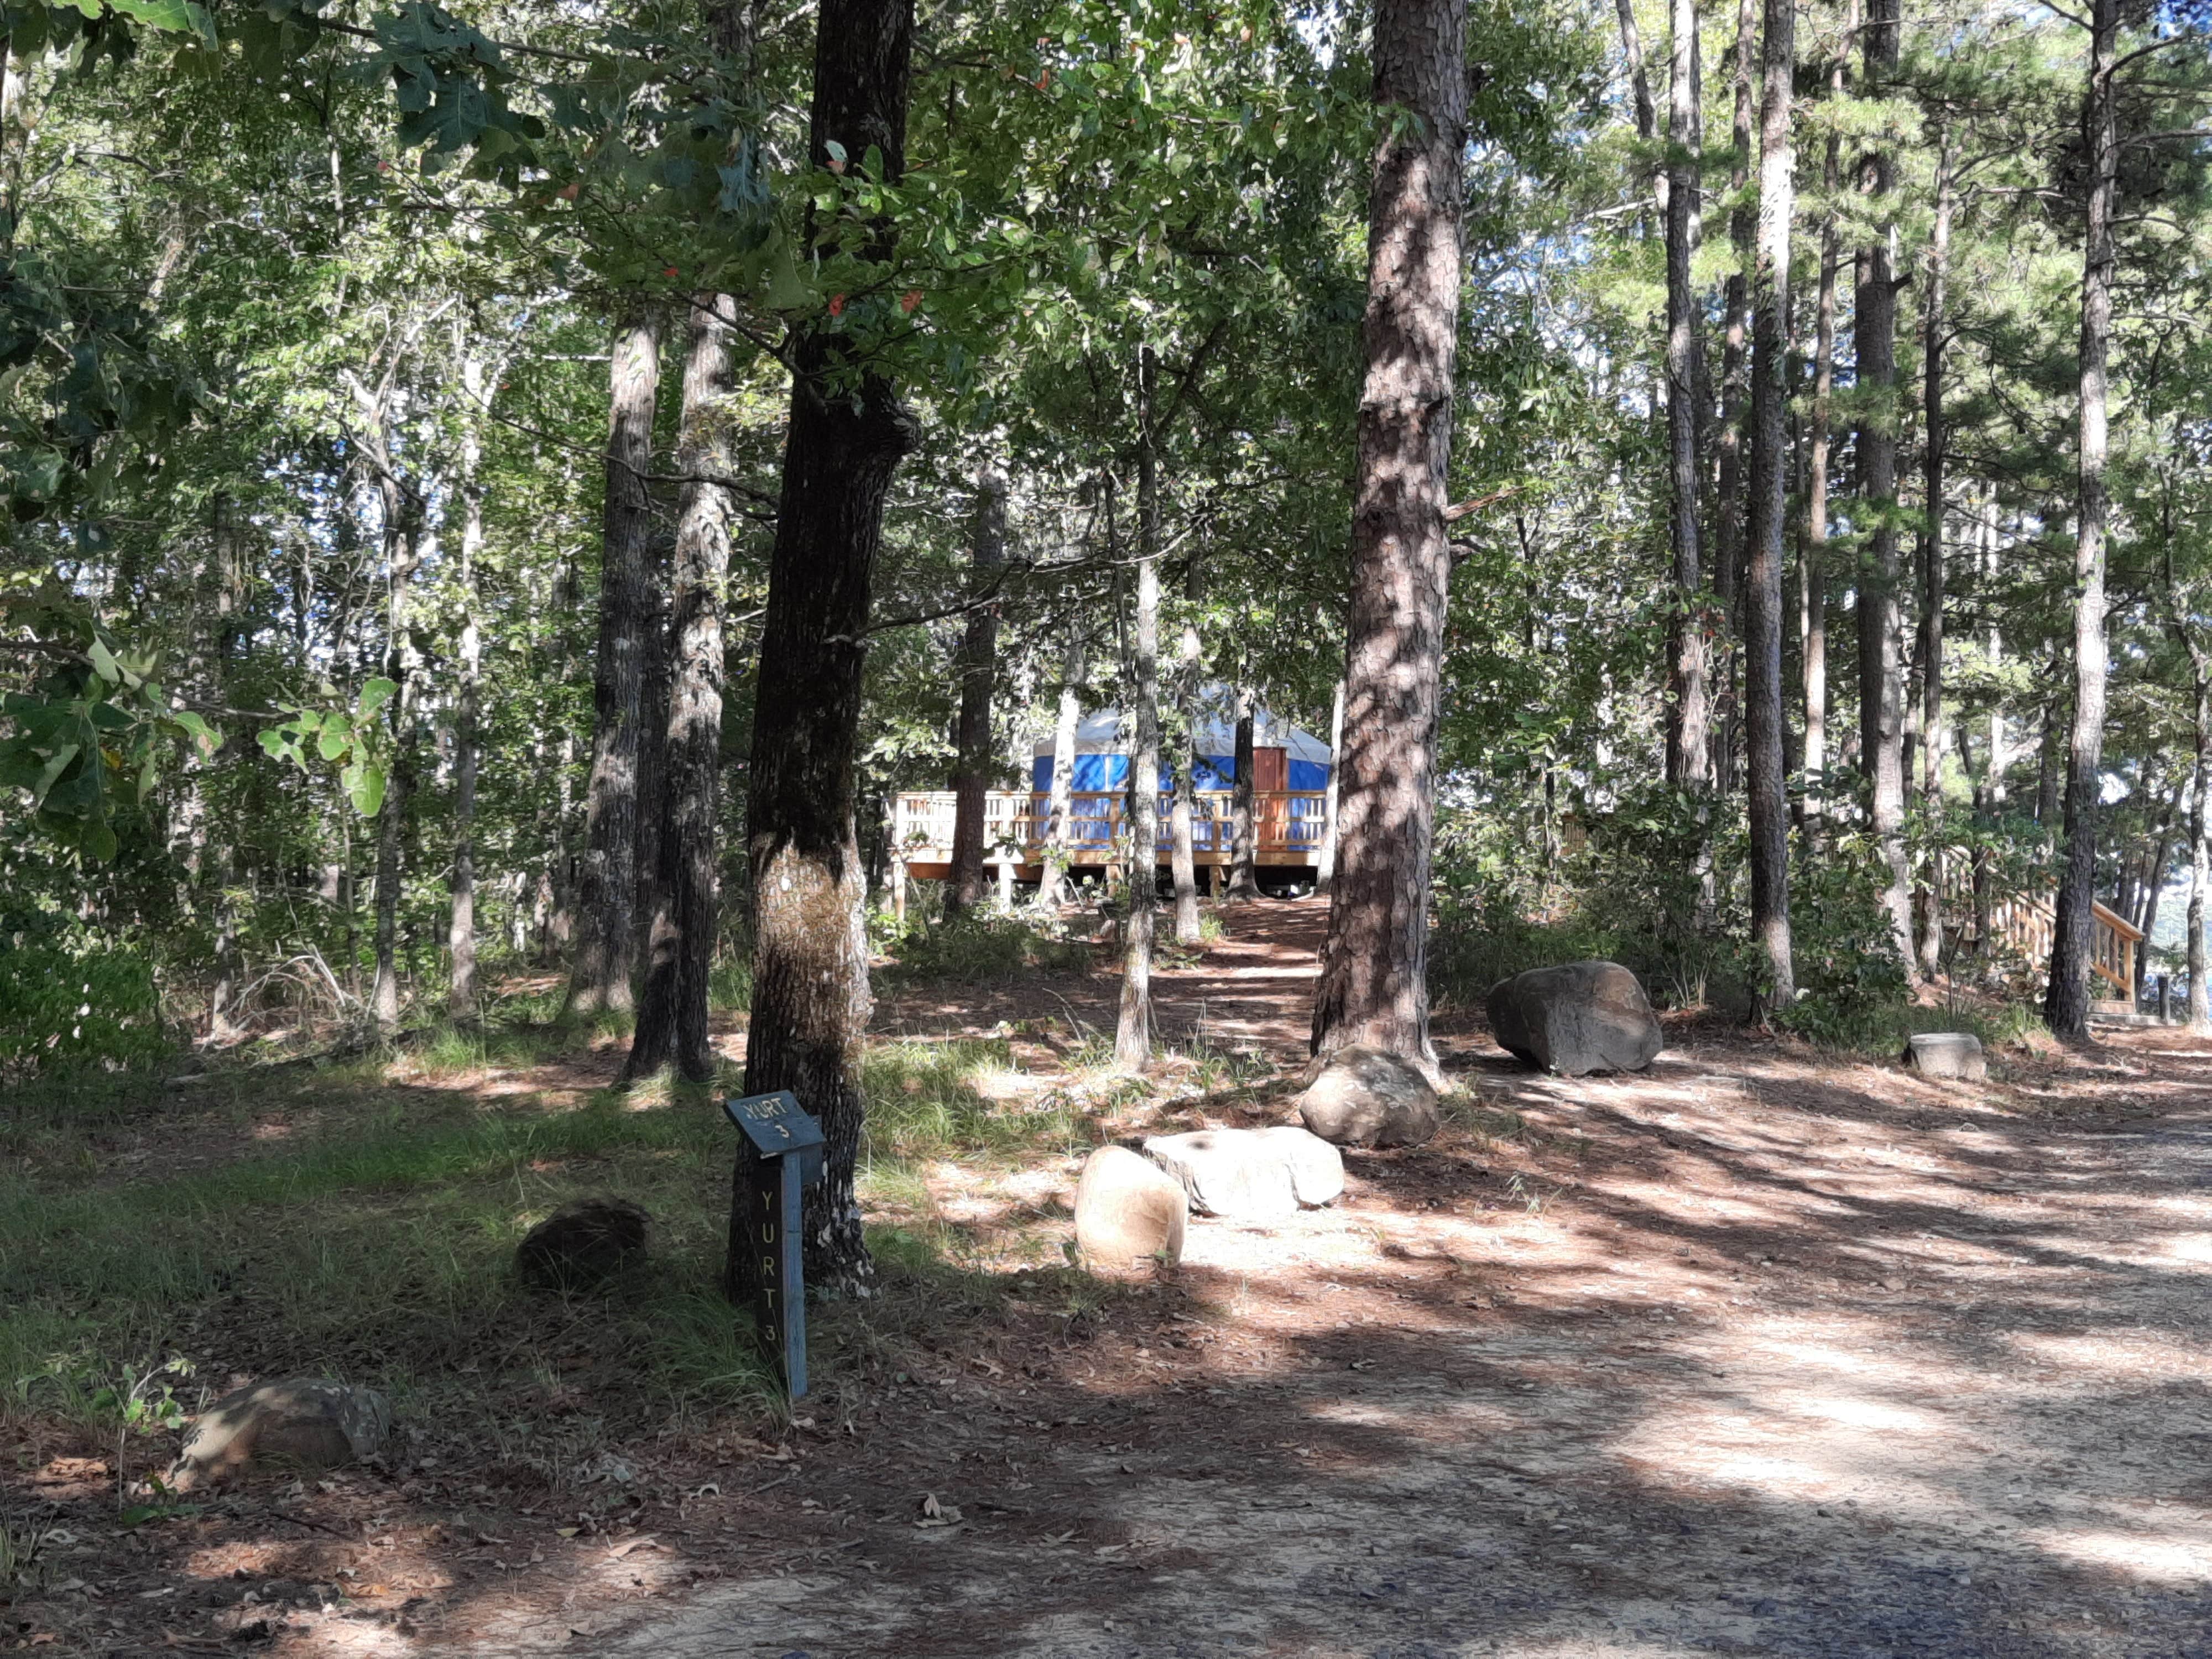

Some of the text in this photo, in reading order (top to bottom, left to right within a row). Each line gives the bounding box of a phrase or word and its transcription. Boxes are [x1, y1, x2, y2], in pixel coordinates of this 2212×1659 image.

[743, 1097, 788, 1120] YURT
[775, 1124, 790, 1138] 3
[761, 1190, 776, 1341] YURT 3
